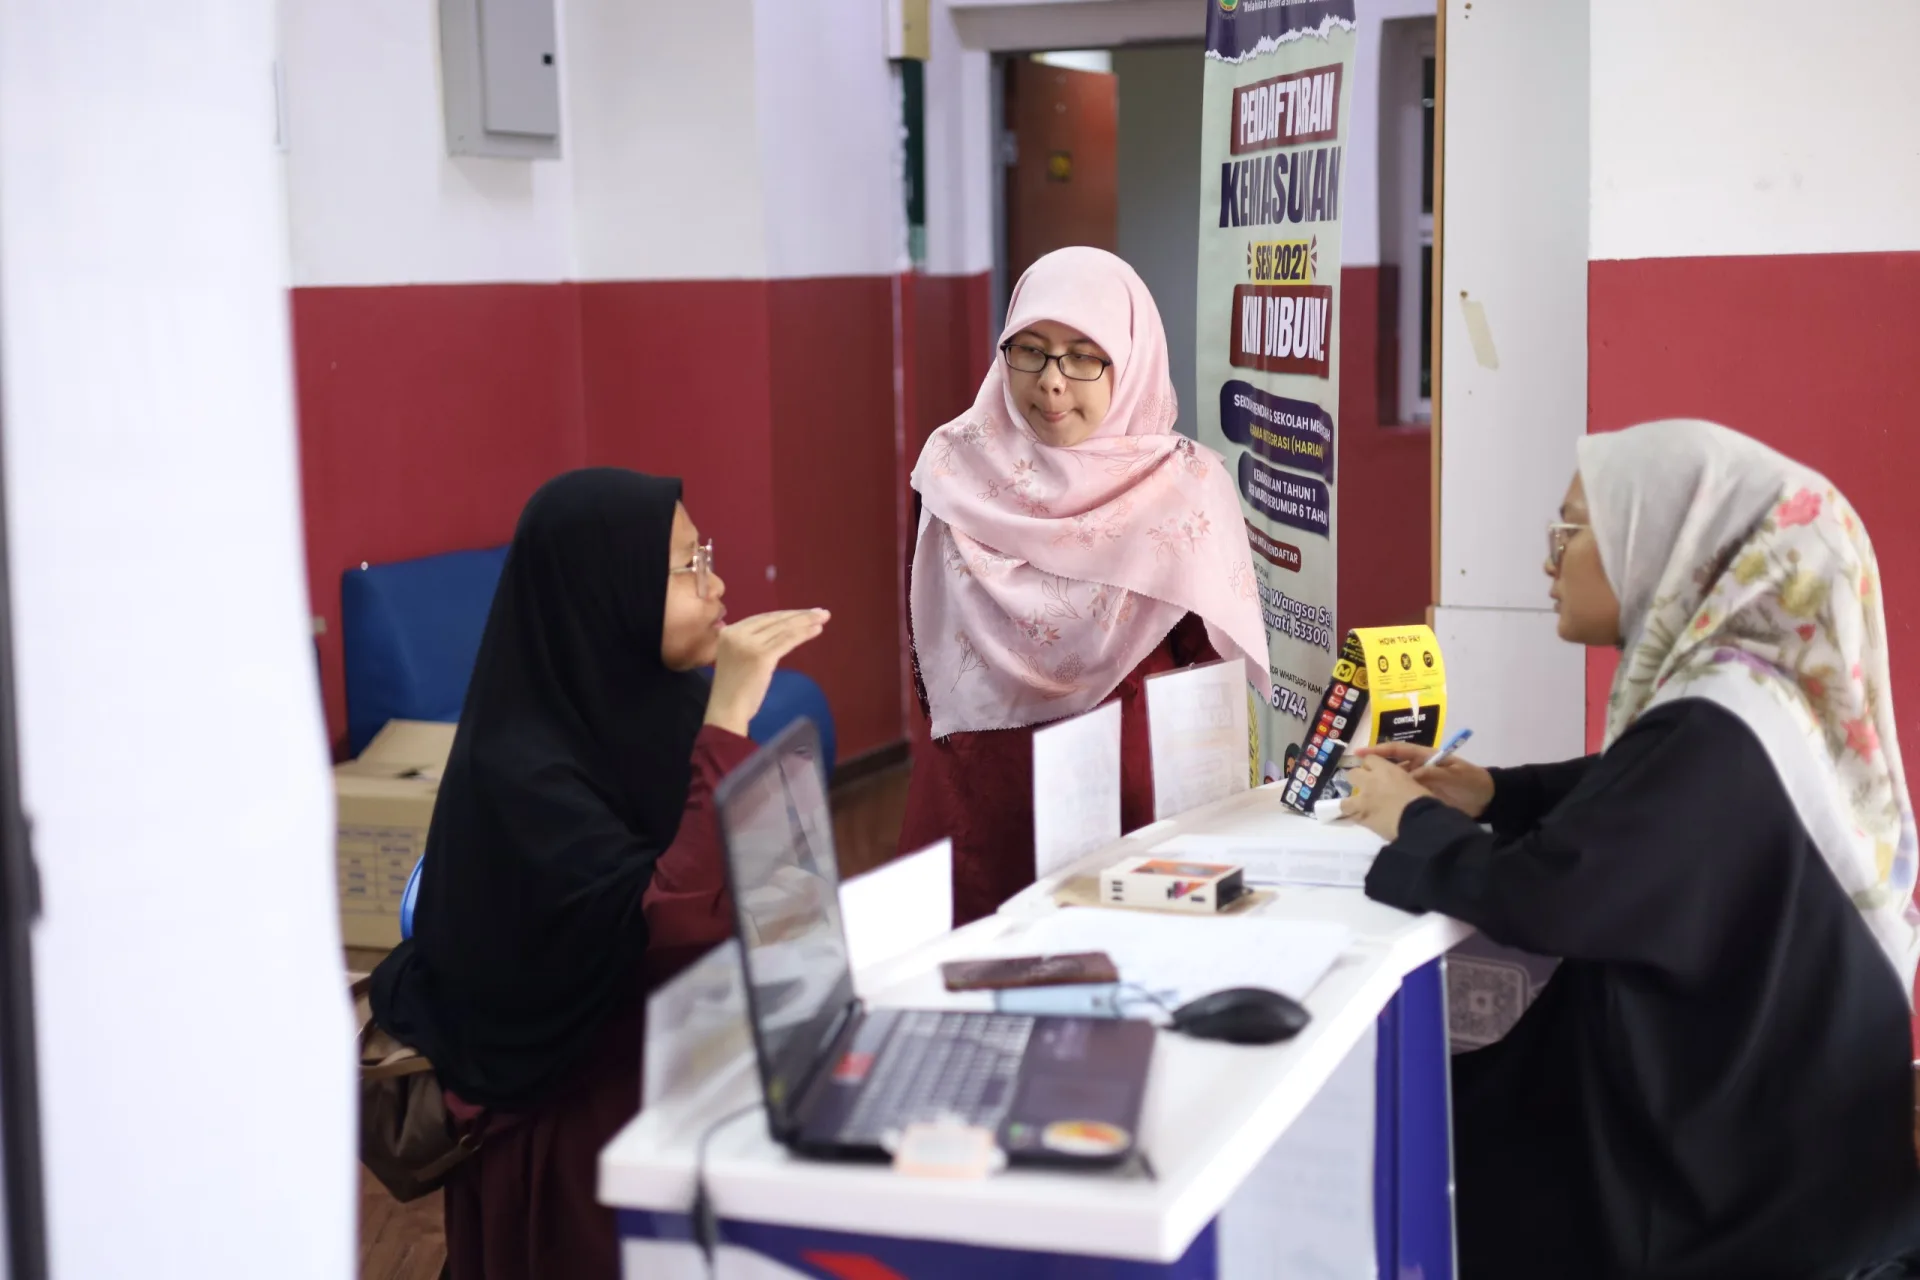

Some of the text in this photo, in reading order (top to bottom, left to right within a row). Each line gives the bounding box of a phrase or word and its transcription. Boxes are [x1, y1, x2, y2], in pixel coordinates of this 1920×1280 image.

[1256, 244, 1308, 280] SESI 2027
[1273, 411, 1308, 430] SEKOLAH
[1283, 482, 1310, 501] TAHUN
[1312, 488, 1316, 502] 1
[1299, 504, 1304, 517] 6
[1271, 589, 1316, 622] Wangsa
[1263, 609, 1293, 637] awati,
[1294, 620, 1330, 653] 53300,
[1379, 634, 1421, 645] HOW TO PAY
[1279, 669, 1307, 687] WHATSAPP
[1308, 682, 1322, 695] KAMI
[1393, 715, 1415, 725] CONTAC
